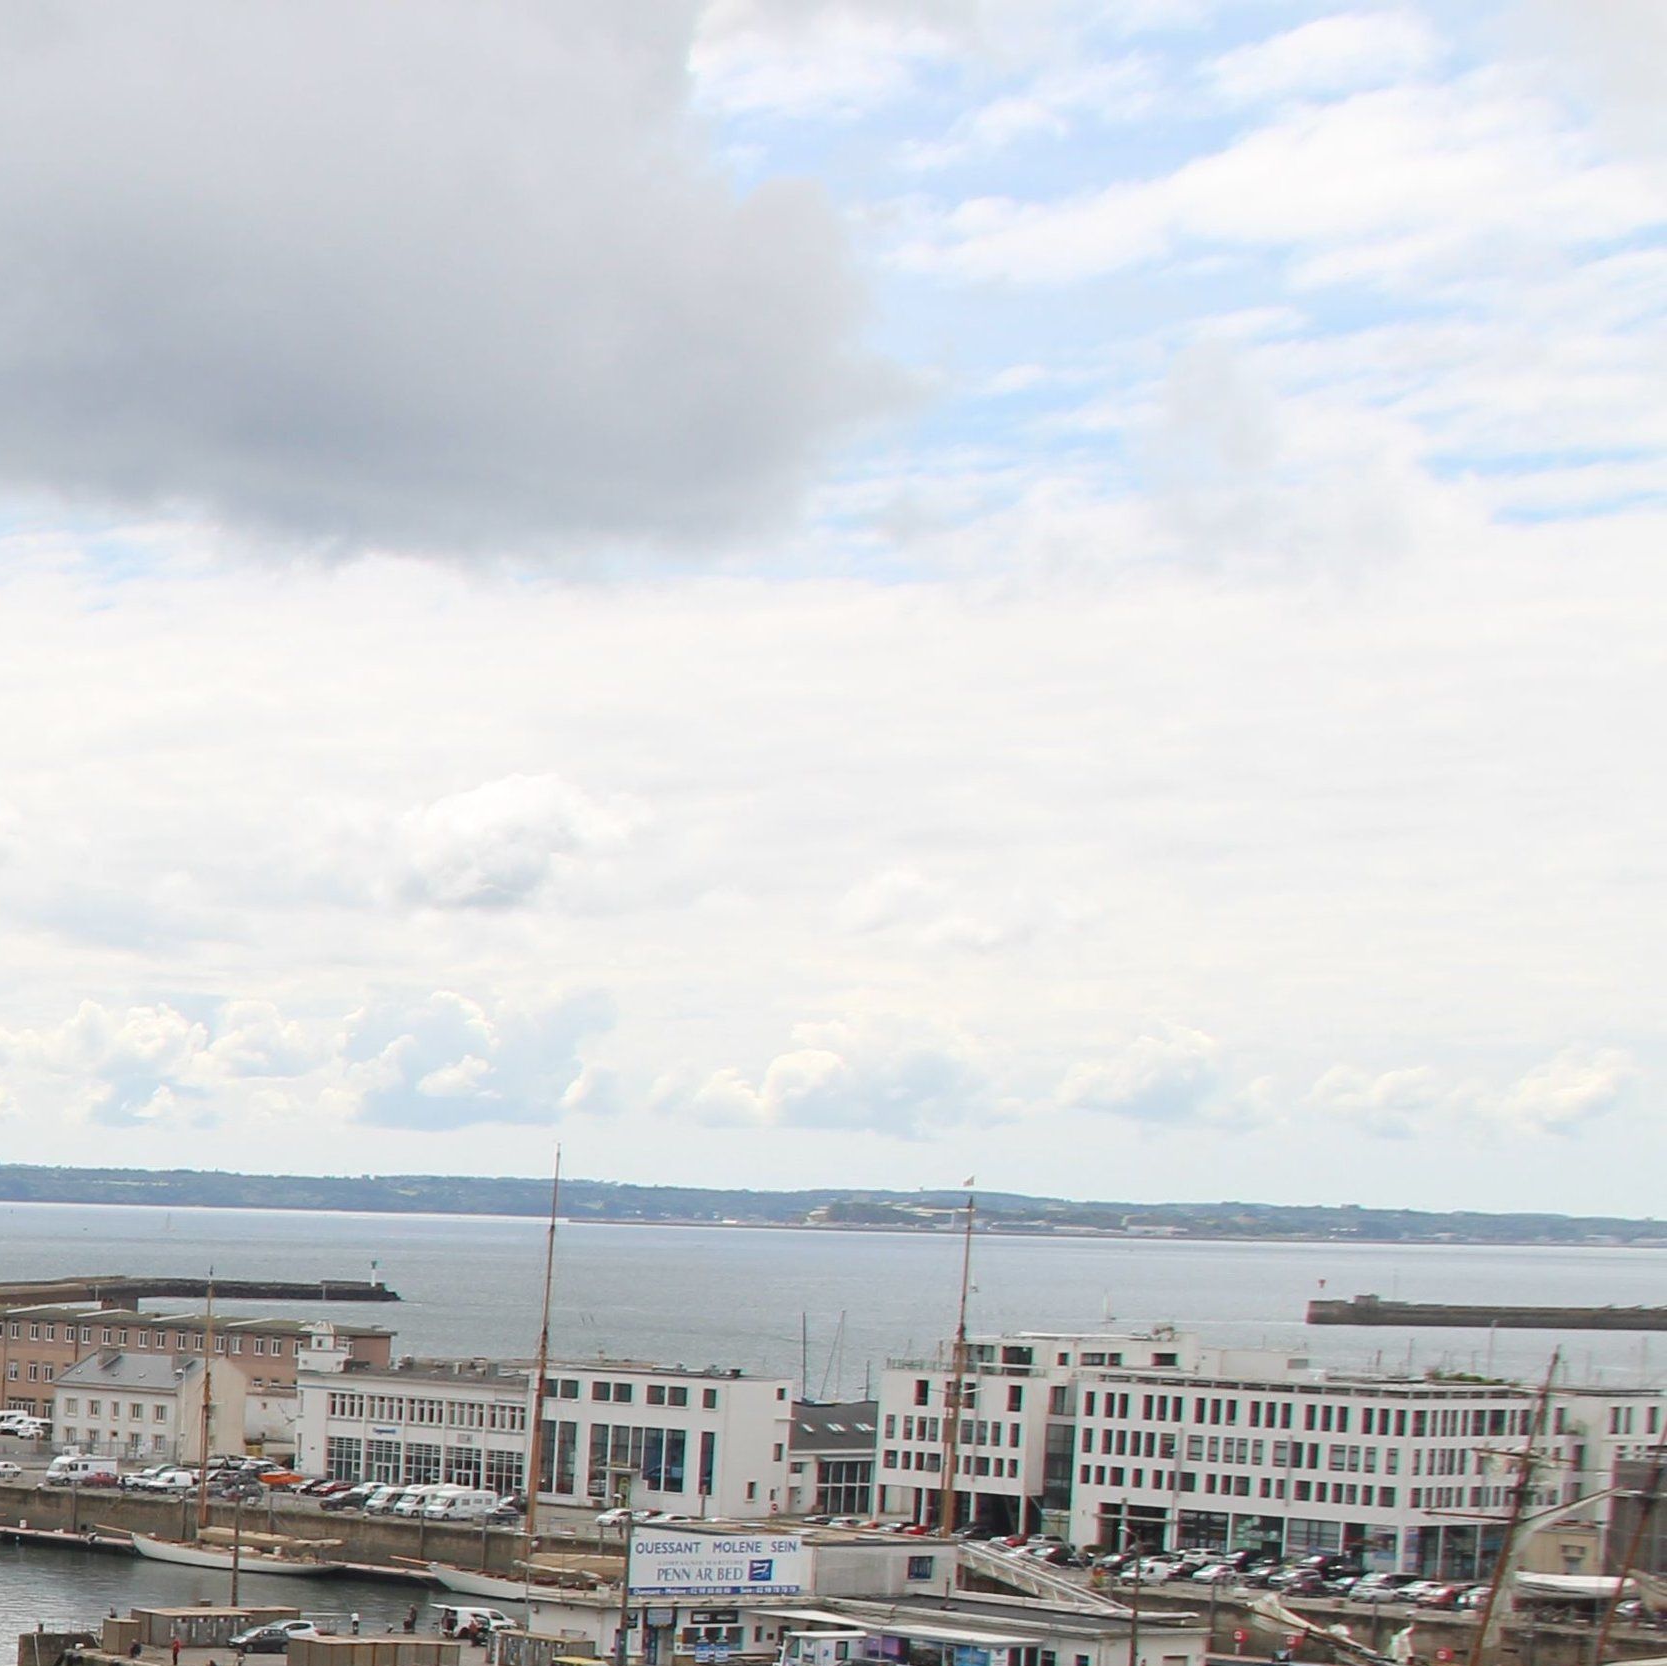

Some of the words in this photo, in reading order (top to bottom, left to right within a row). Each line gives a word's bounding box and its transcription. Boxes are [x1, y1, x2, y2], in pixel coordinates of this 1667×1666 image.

[635, 1542, 701, 1554] OUESSANT
[713, 1541, 761, 1553] MOLENE
[770, 1541, 797, 1553] SEIN
[657, 1568, 690, 1581] PENN
[695, 1568, 713, 1581] AR
[717, 1567, 743, 1581] BED
